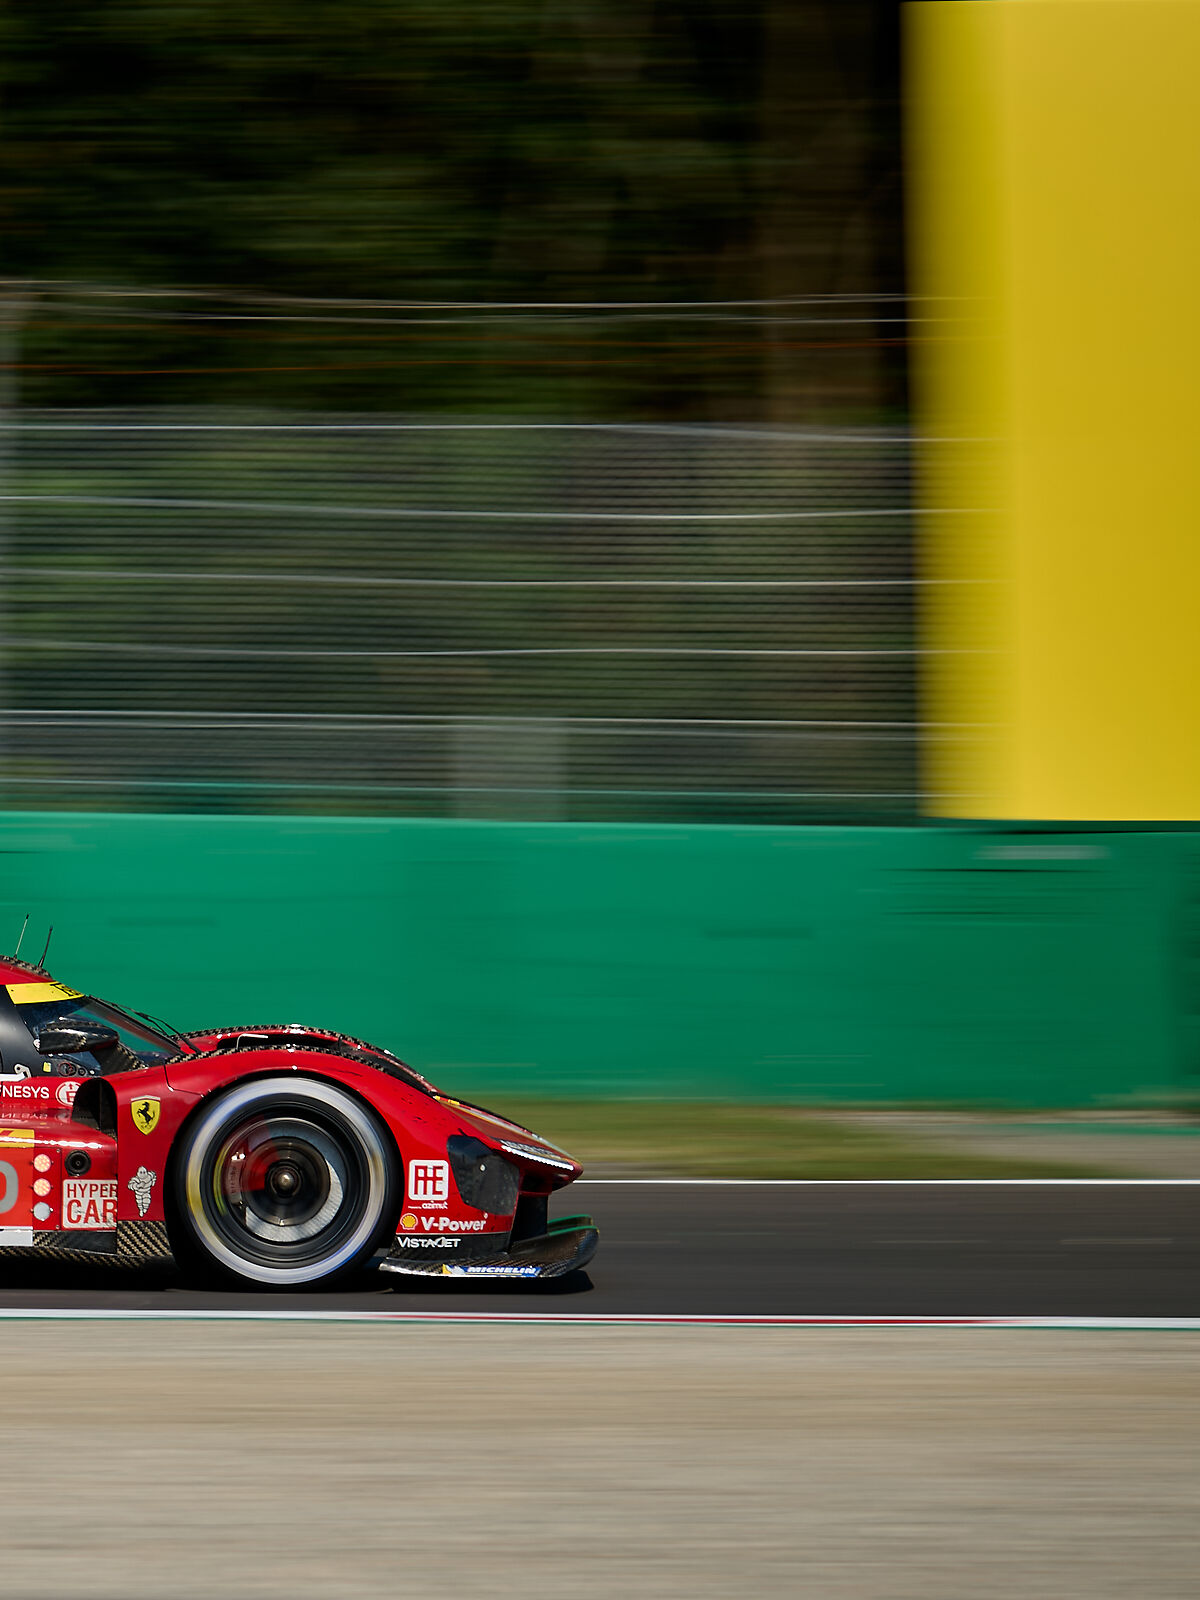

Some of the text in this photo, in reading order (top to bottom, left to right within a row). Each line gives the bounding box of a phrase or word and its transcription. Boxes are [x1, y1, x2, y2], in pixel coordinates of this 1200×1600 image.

[66, 1183, 117, 1198] HYPER
[66, 1199, 117, 1224] CAR
[420, 1216, 487, 1231] V-Power
[467, 1266, 537, 1274] MICHELIN
